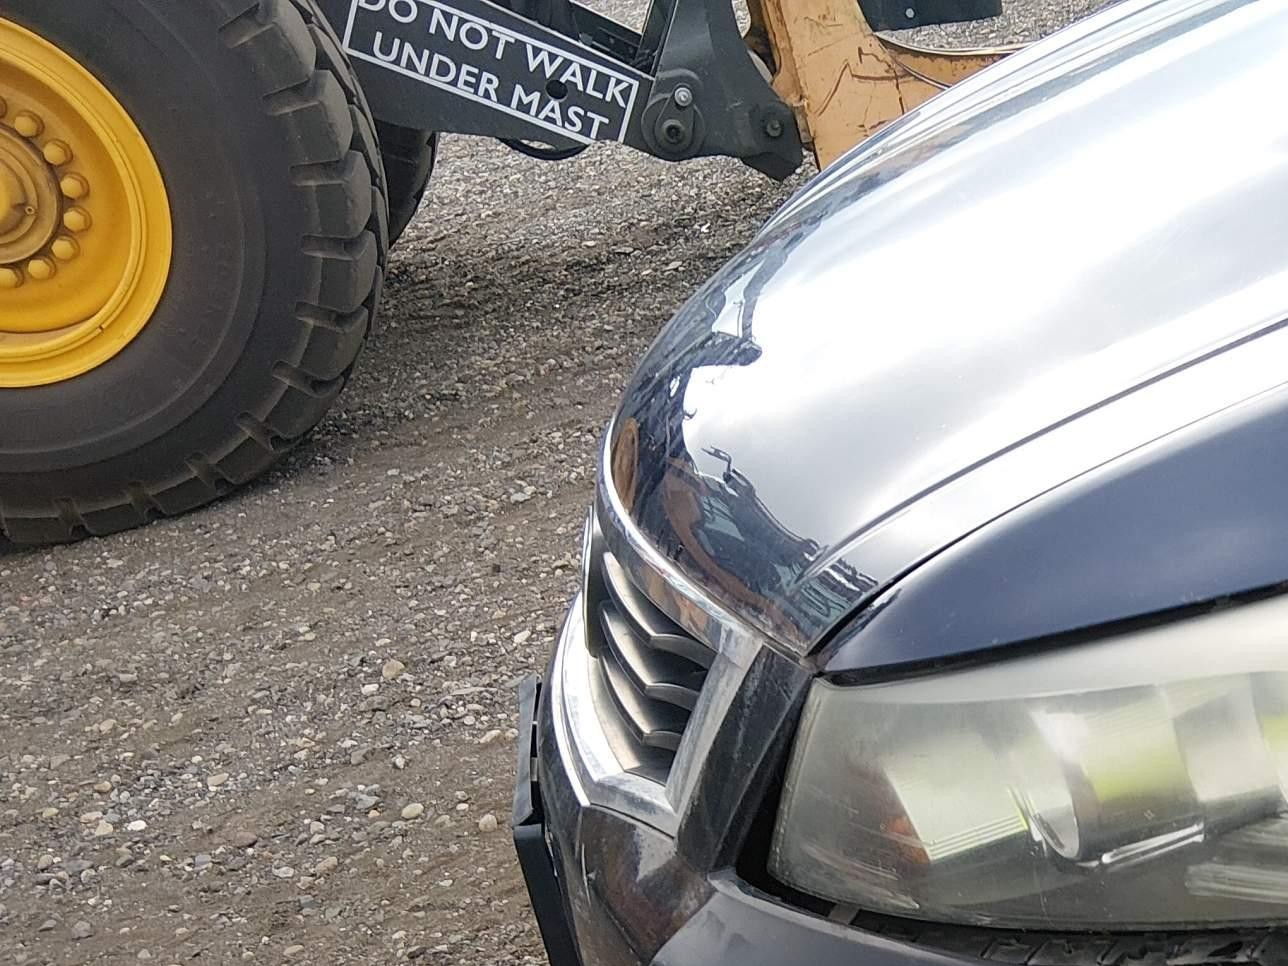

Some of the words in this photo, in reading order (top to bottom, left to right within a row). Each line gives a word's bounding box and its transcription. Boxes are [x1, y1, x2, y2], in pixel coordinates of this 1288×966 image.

[373, 31, 498, 102] UNDER
[510, 83, 609, 139] MAST
[428, 8, 516, 60] NOT
[526, 43, 629, 109] WALK
